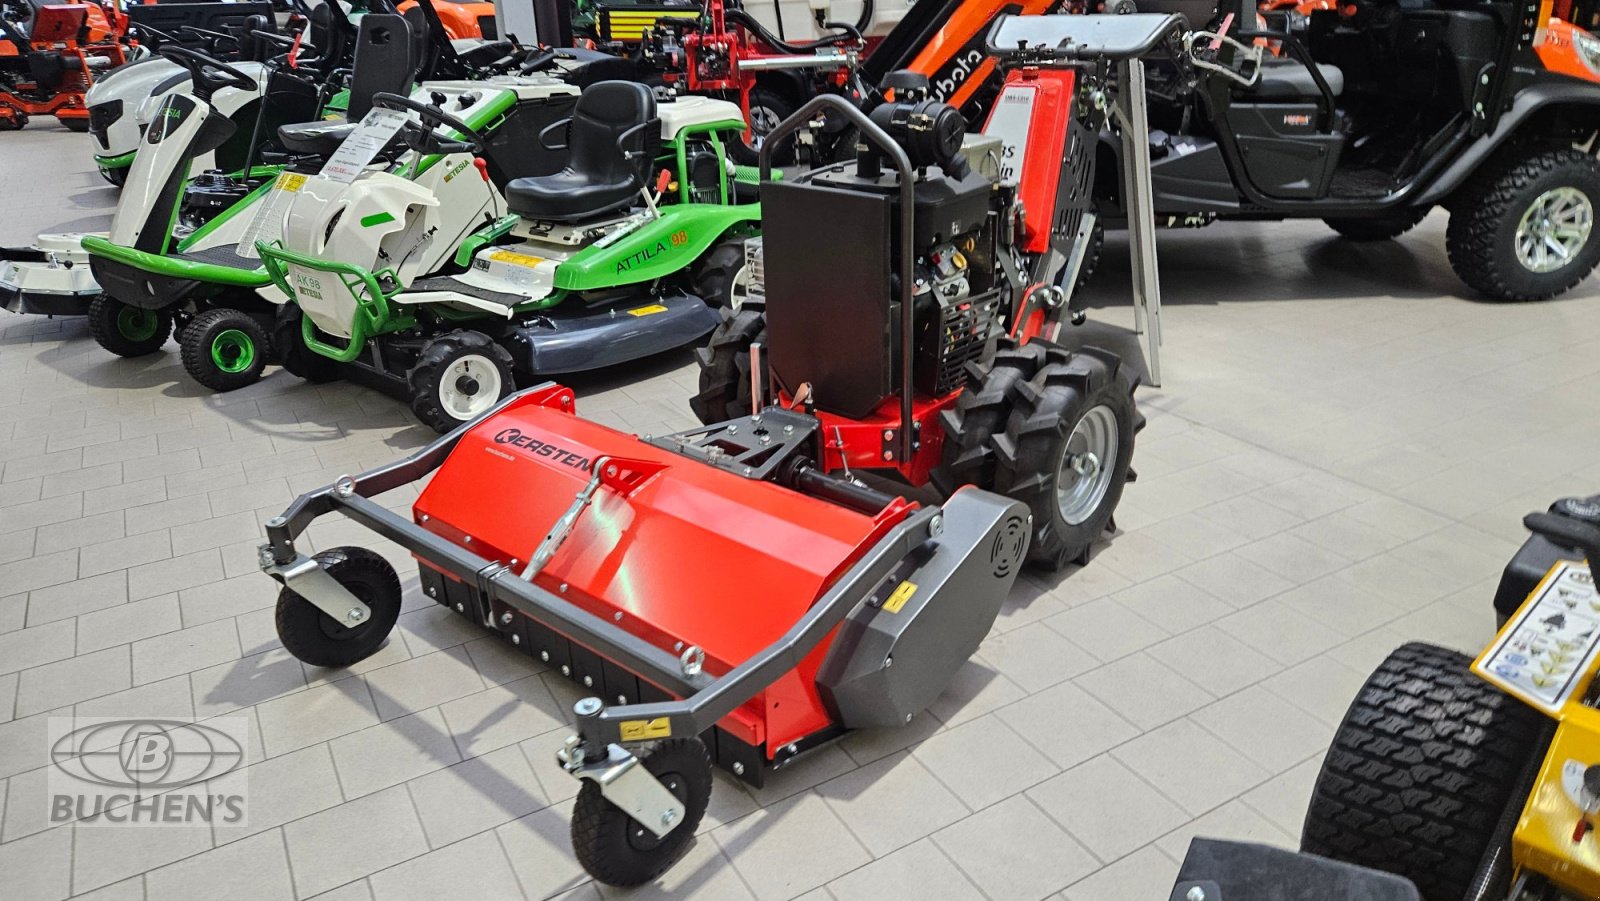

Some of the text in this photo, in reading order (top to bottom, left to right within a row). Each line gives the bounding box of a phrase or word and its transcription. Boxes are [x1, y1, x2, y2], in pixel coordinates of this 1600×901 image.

[929, 50, 983, 103] ubota
[1001, 146, 1016, 158] BS
[444, 159, 470, 183] ETESIA
[1000, 163, 1014, 177] in
[616, 230, 688, 275] ATTILA 98
[494, 428, 591, 473] KERSTEN
